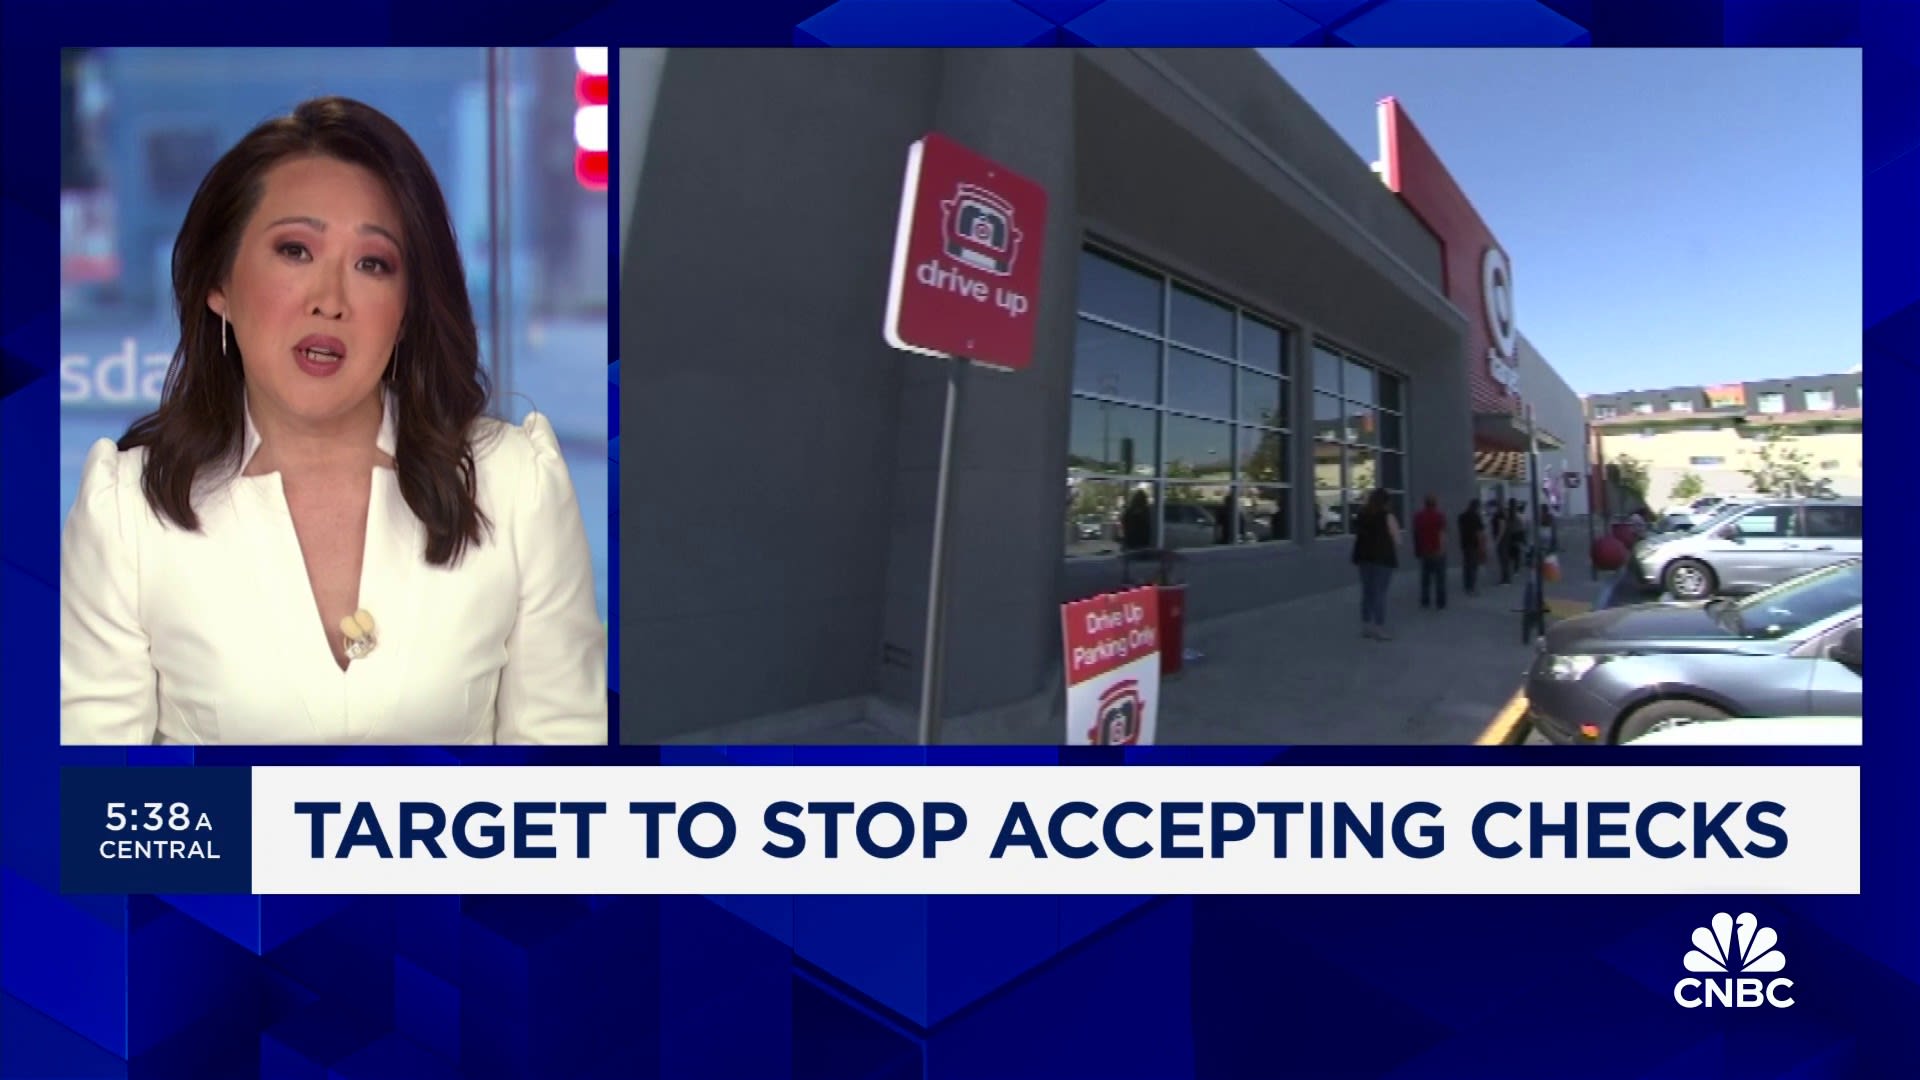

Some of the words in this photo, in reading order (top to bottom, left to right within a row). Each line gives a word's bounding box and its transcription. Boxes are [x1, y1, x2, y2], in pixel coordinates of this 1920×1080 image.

[917, 260, 989, 302] drive
[996, 288, 1028, 317] up
[1086, 610, 1122, 634] Drive
[1123, 603, 1144, 623] Up
[1073, 638, 1127, 670] Parking
